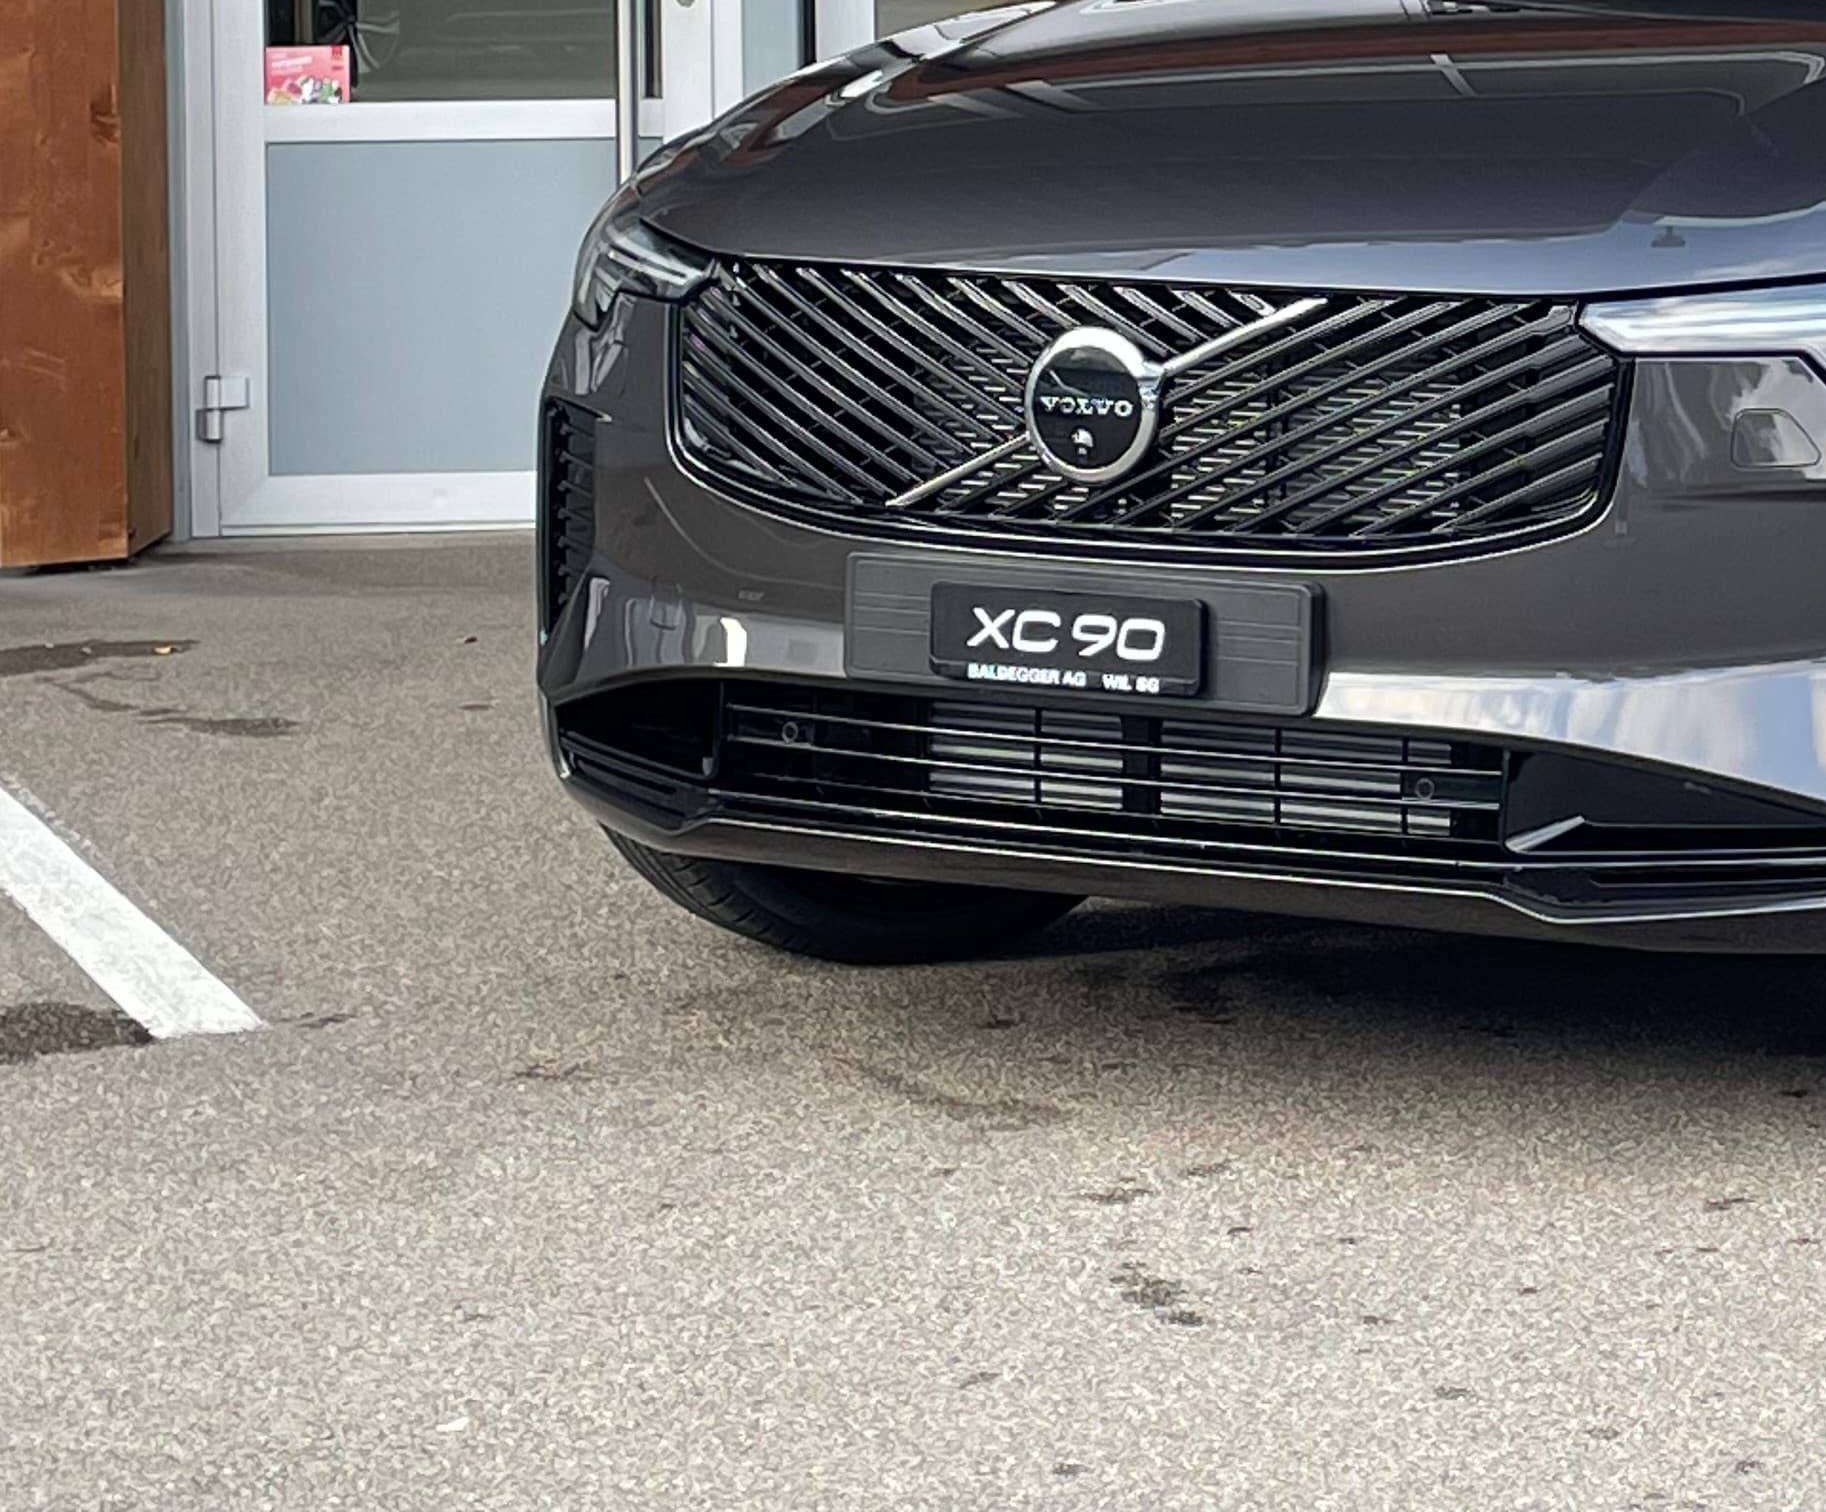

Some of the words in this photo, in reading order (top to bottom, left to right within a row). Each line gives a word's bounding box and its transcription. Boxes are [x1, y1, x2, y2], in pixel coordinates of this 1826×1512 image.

[1039, 395, 1134, 417] VOLVO
[966, 607, 1062, 653] XC
[1071, 613, 1166, 661] 90
[966, 662, 1060, 686] BALDEGGER
[1061, 670, 1087, 688] AG
[1101, 673, 1132, 692] WIL
